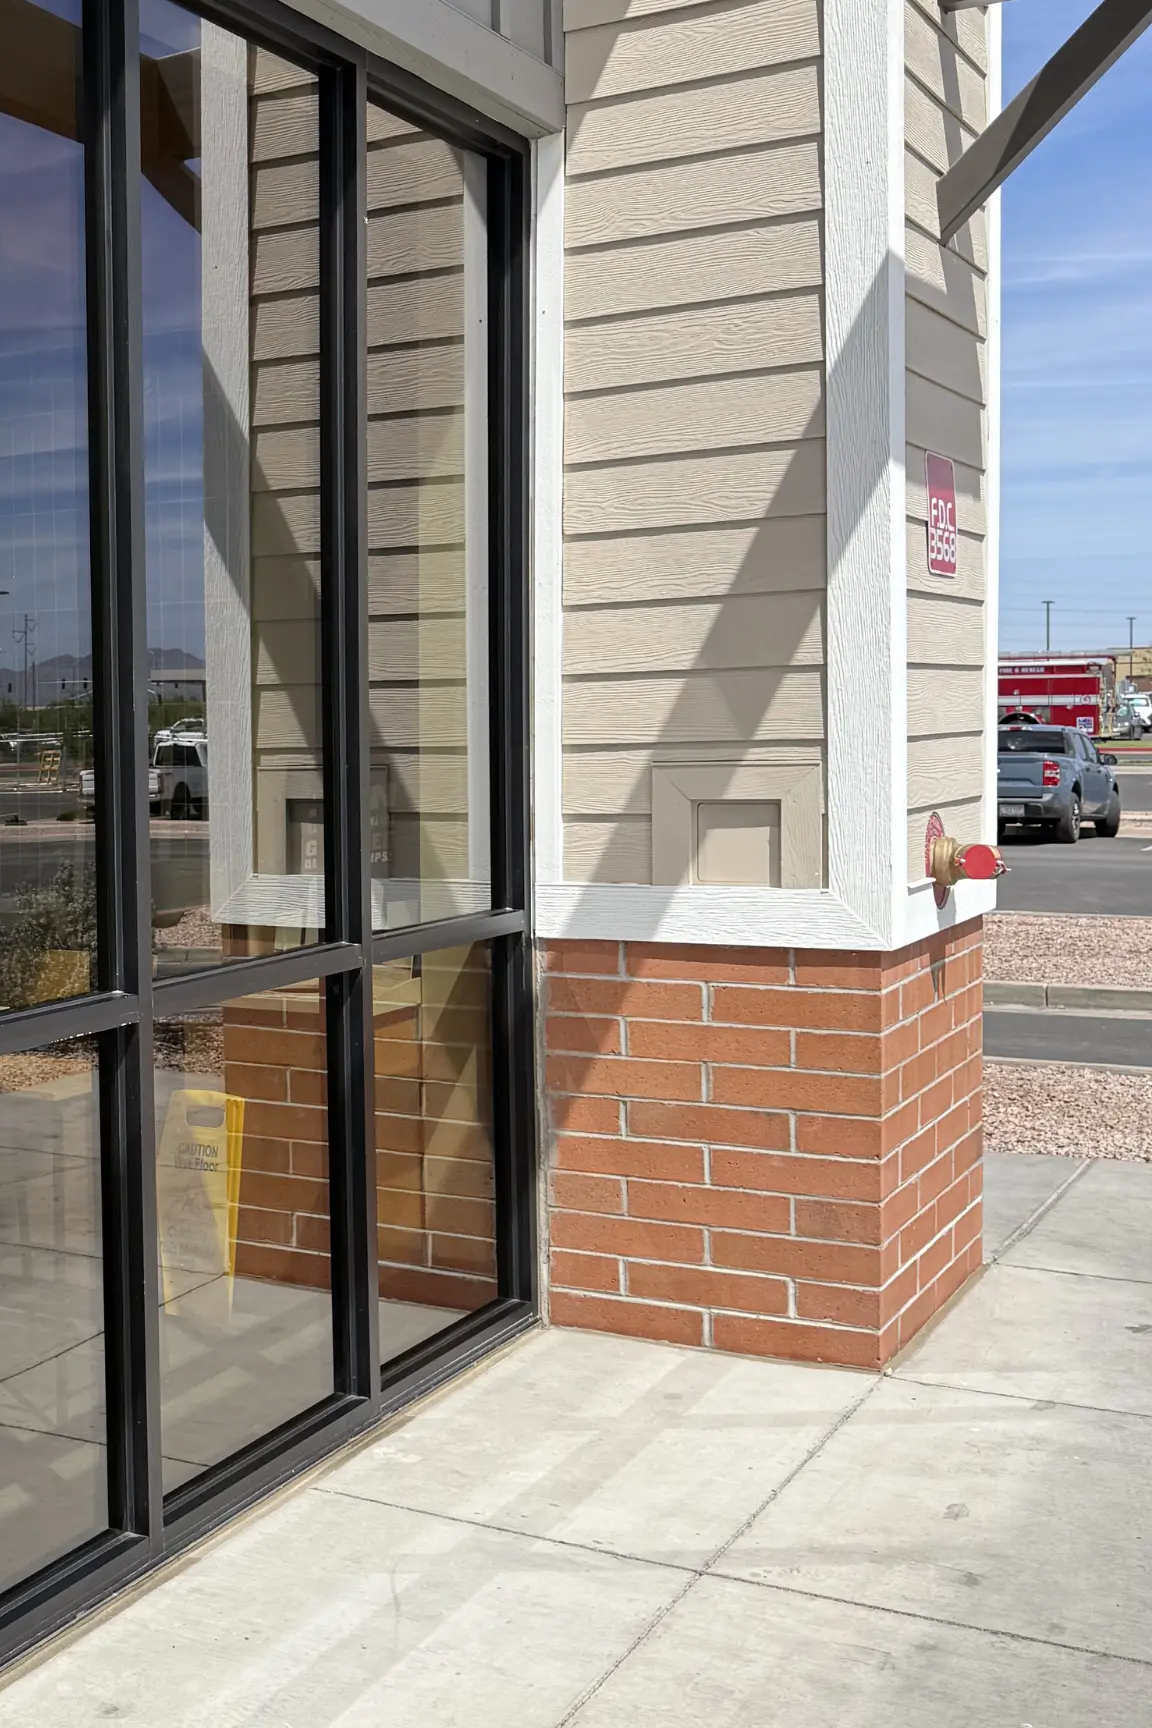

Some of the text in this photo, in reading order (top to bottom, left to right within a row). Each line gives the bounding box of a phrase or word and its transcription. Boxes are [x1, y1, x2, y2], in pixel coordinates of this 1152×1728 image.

[930, 527, 956, 564] 3568
[178, 1142, 219, 1158] CAUTION
[195, 1157, 219, 1172] Floor
